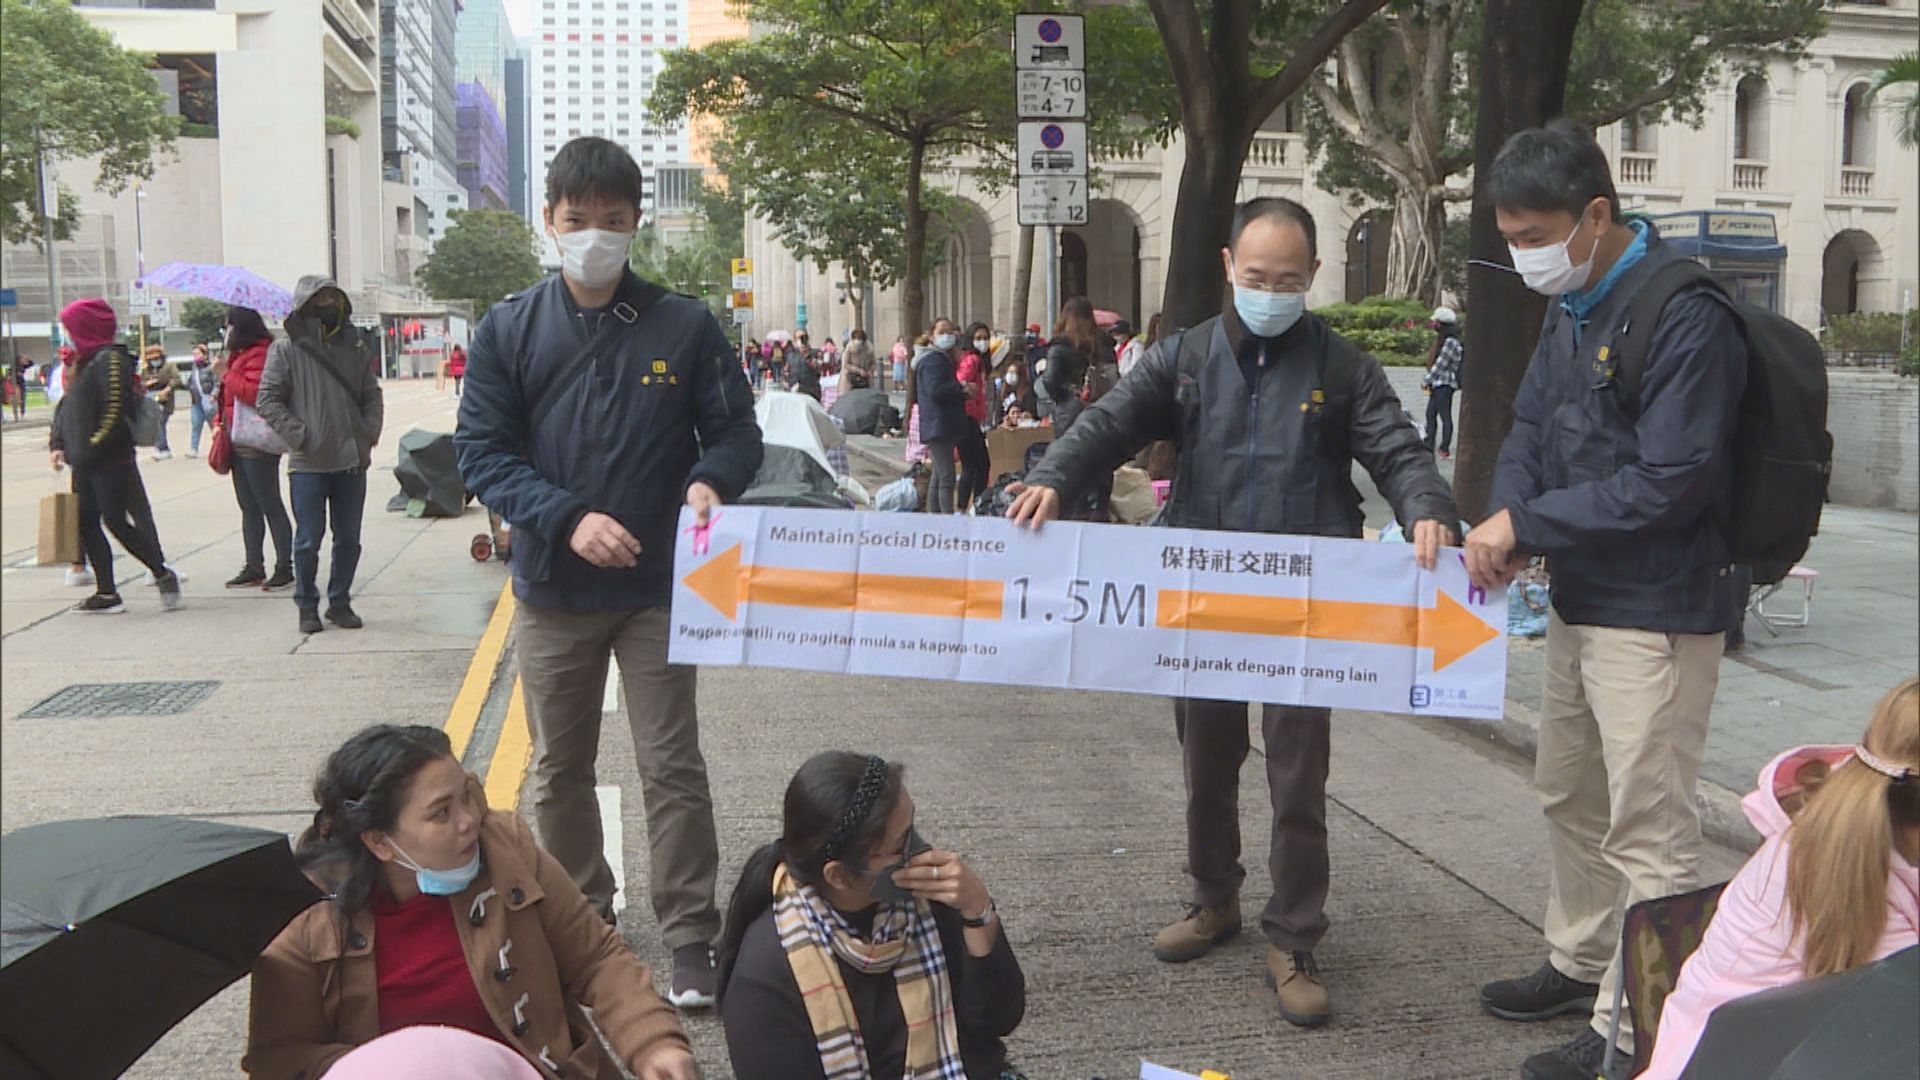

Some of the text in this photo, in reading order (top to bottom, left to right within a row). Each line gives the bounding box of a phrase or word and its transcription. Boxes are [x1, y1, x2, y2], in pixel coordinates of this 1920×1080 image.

[1041, 76, 1081, 93] 7-10
[1066, 180, 1077, 195] 7
[1067, 205, 1084, 221] 12
[770, 526, 1006, 553] Maintain Social Distance
[1161, 545, 1313, 577] 保持社交距離
[1013, 577, 1146, 627] 1.5M
[777, 630, 795, 643] ng
[800, 631, 856, 646] pagitan
[860, 635, 896, 649] mula
[899, 641, 915, 650] sa
[919, 638, 998, 656] kapwa-tao
[1154, 654, 1378, 683] Jaga jarak dengan orang lain
